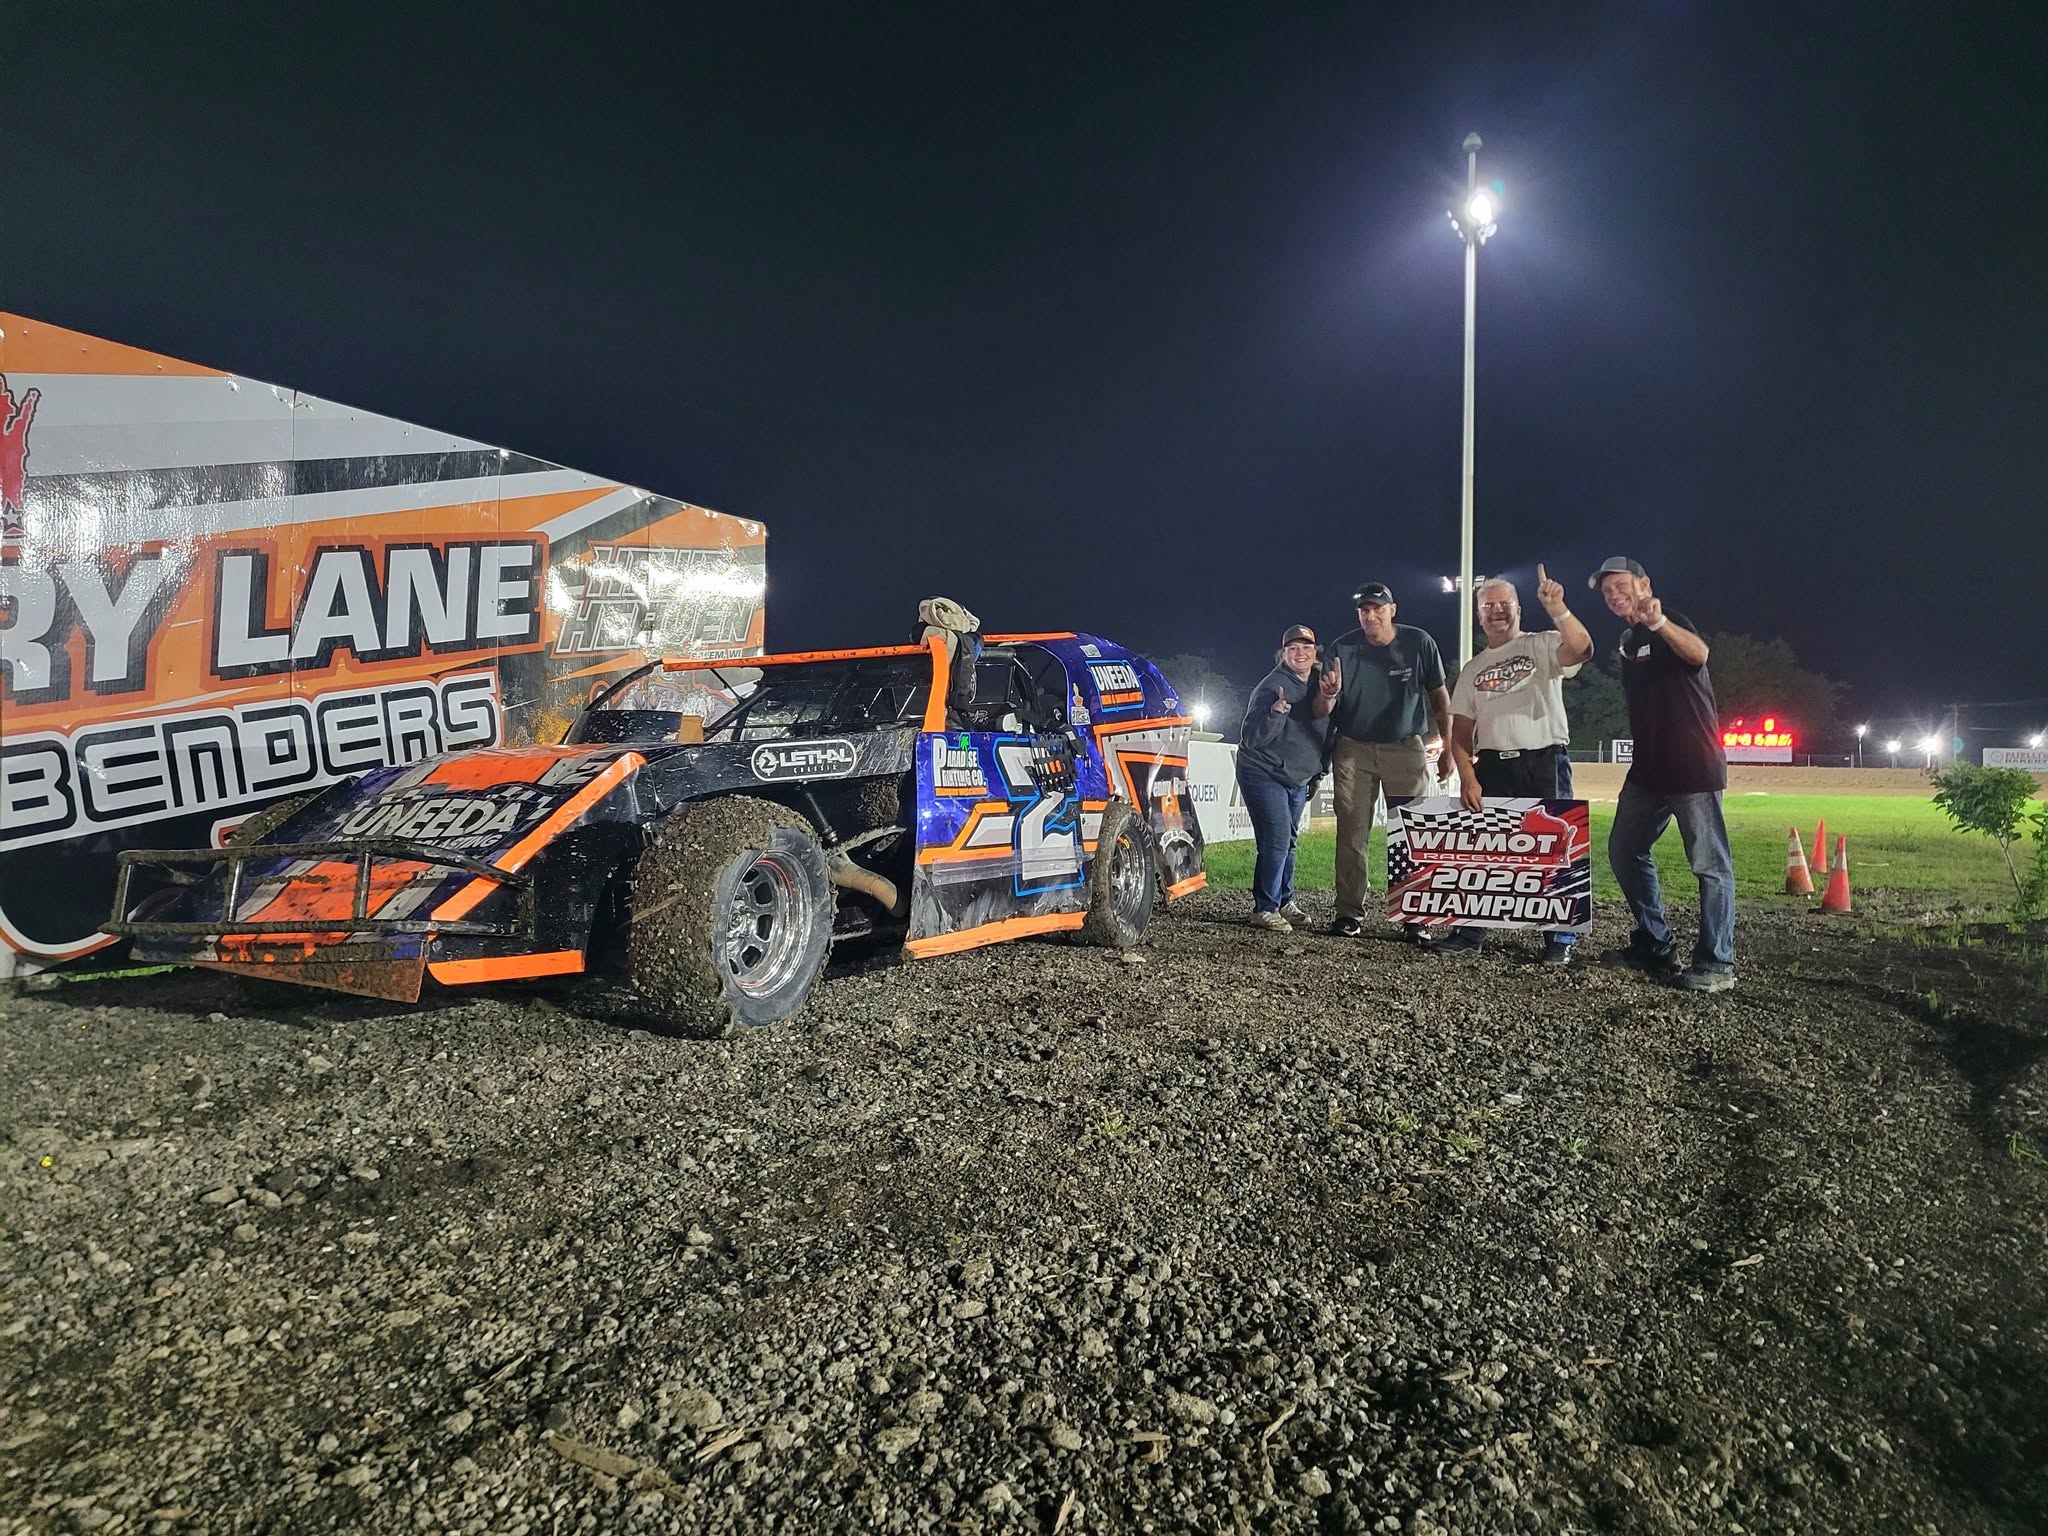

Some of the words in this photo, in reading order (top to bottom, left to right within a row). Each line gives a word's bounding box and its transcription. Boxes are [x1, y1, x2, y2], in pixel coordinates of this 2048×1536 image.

[217, 545, 534, 667] LANE
[728, 649, 742, 657] WI
[1091, 664, 1140, 691] UNEEDA
[1474, 658, 1535, 687] OUTLAWS
[0, 677, 500, 838] BENDERS
[780, 748, 852, 767] LETHAL
[933, 738, 978, 774] PARADISE
[972, 769, 987, 787] CO.
[342, 798, 521, 838] UNEEDA
[1409, 830, 1558, 854] WILMOT
[1423, 852, 1540, 863] RACEWAY
[1431, 867, 1543, 893] 2026
[1401, 891, 1573, 921] CHAMPION
